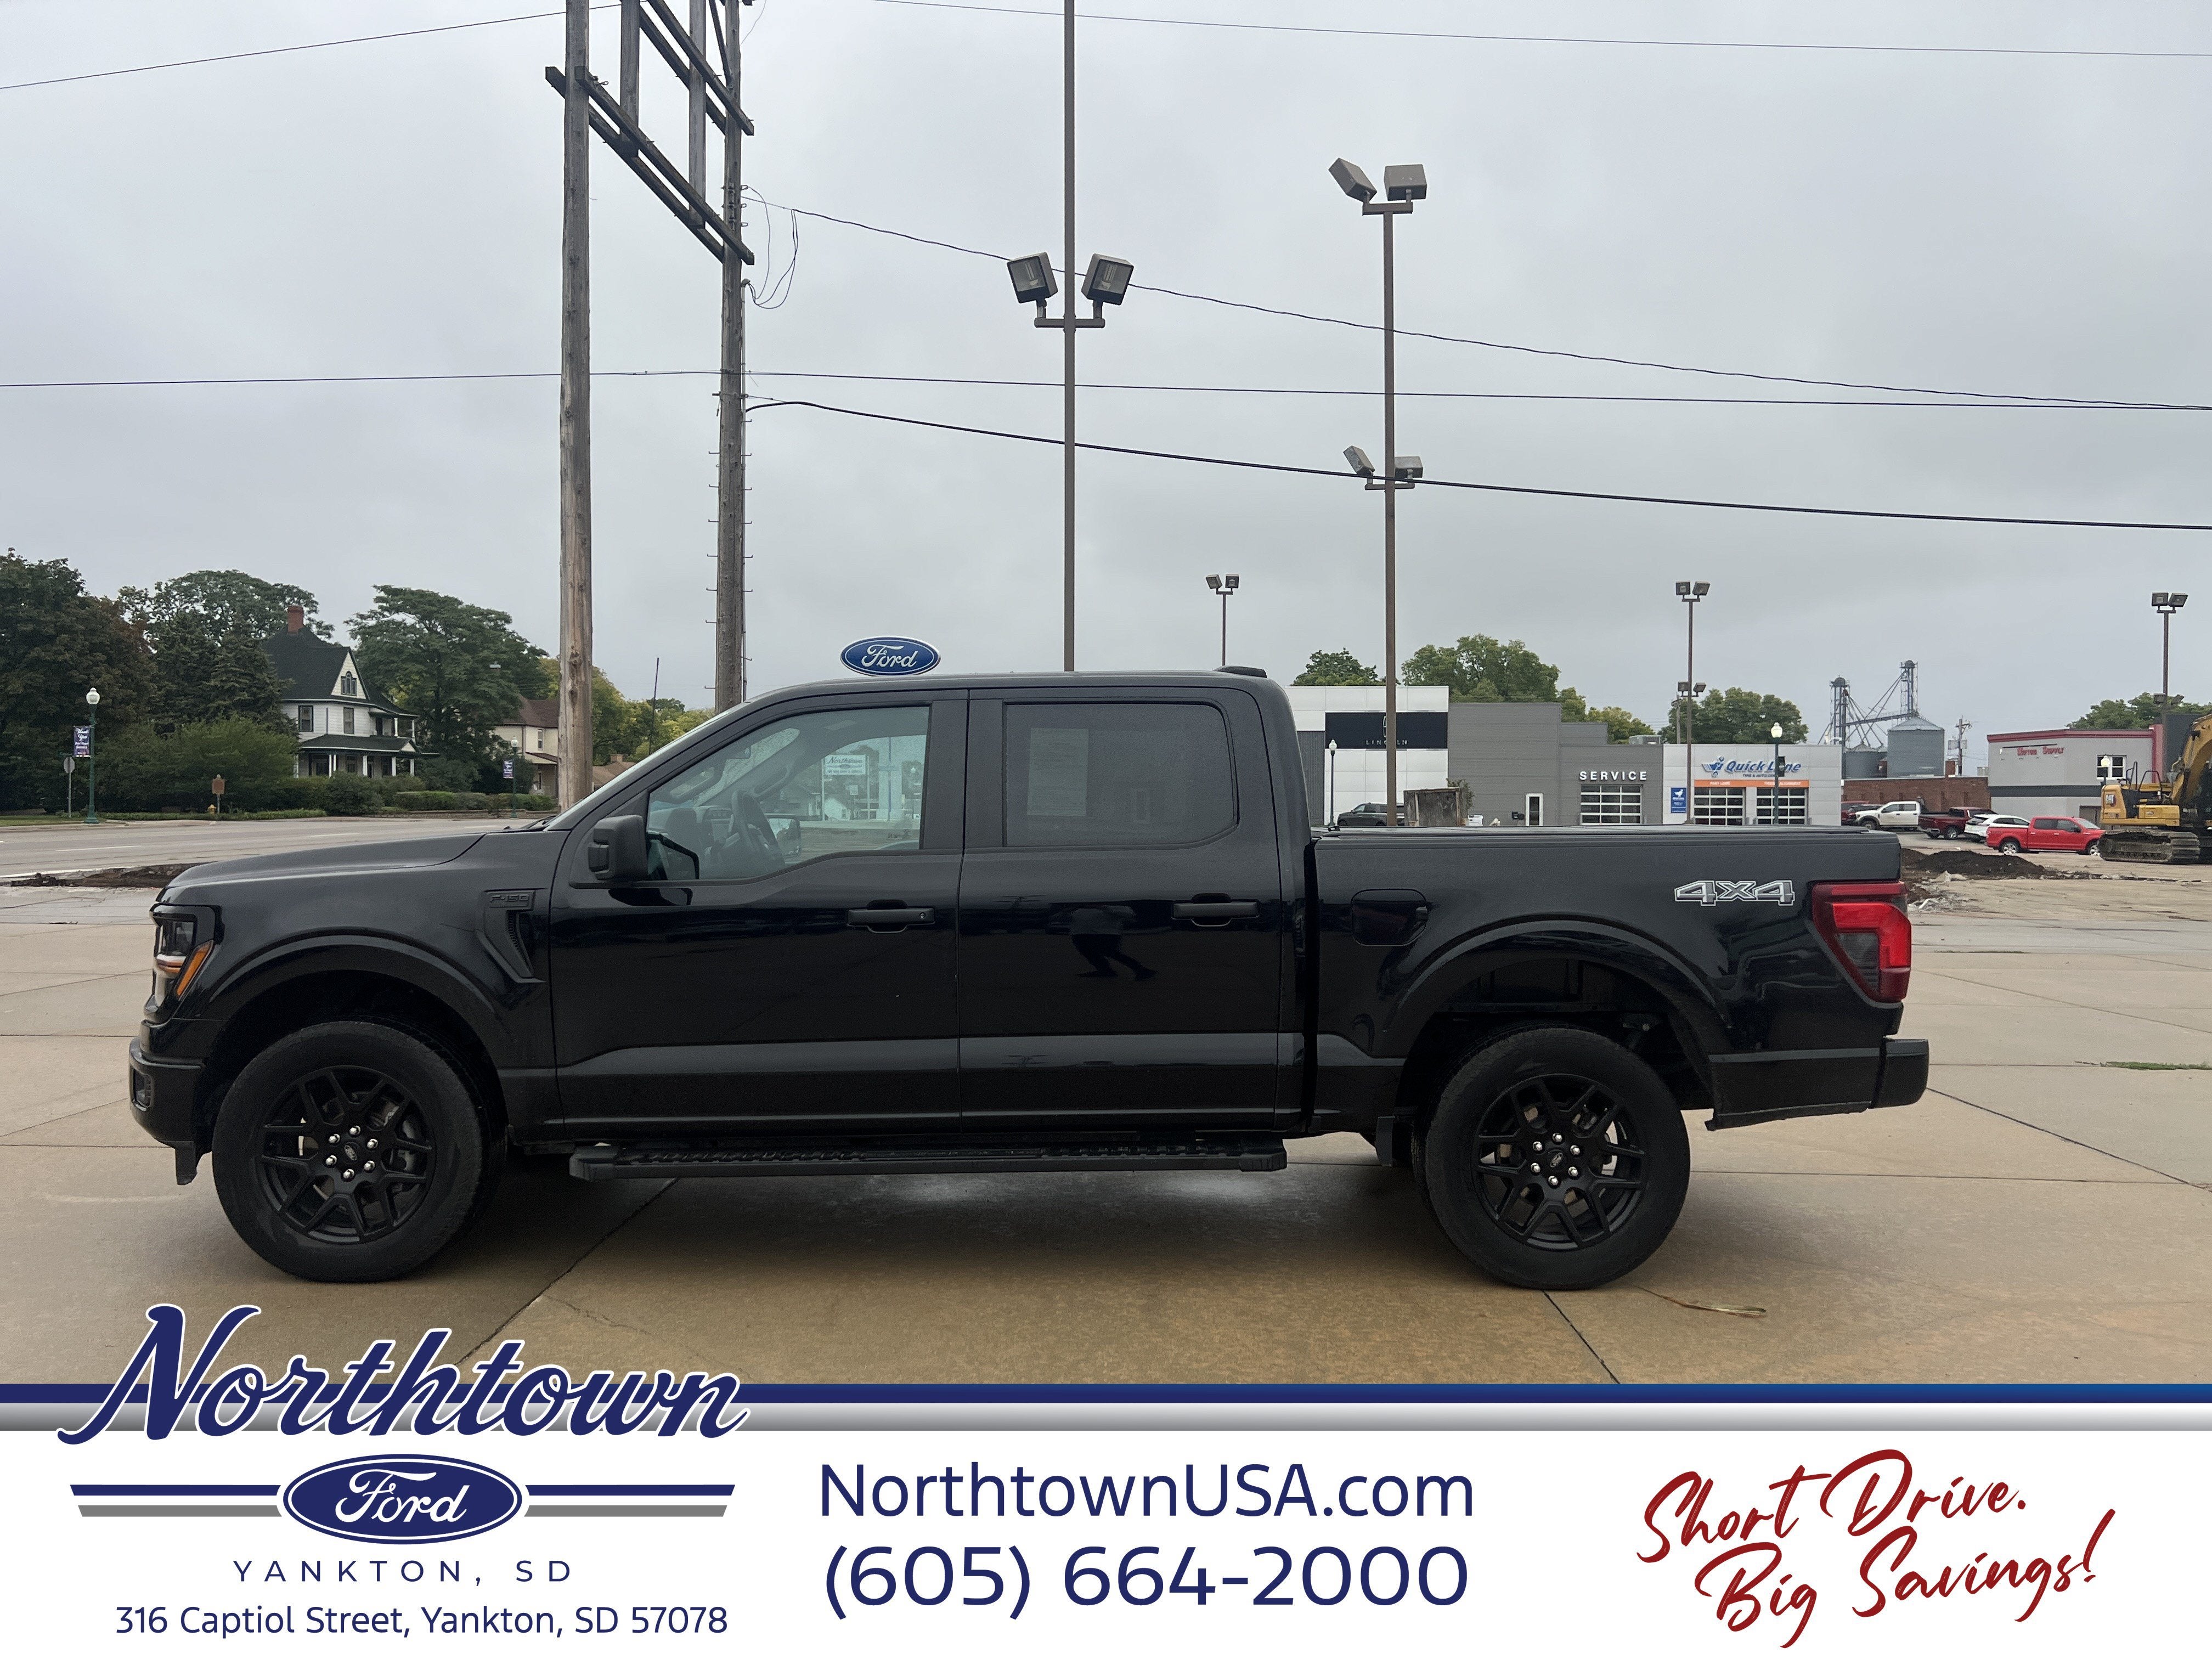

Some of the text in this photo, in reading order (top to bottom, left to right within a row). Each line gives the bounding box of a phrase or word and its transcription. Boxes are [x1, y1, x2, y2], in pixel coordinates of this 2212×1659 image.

[861, 644, 918, 667] Ford
[1725, 760, 1802, 772] Quick Lne
[1579, 771, 1647, 781] SERVICE
